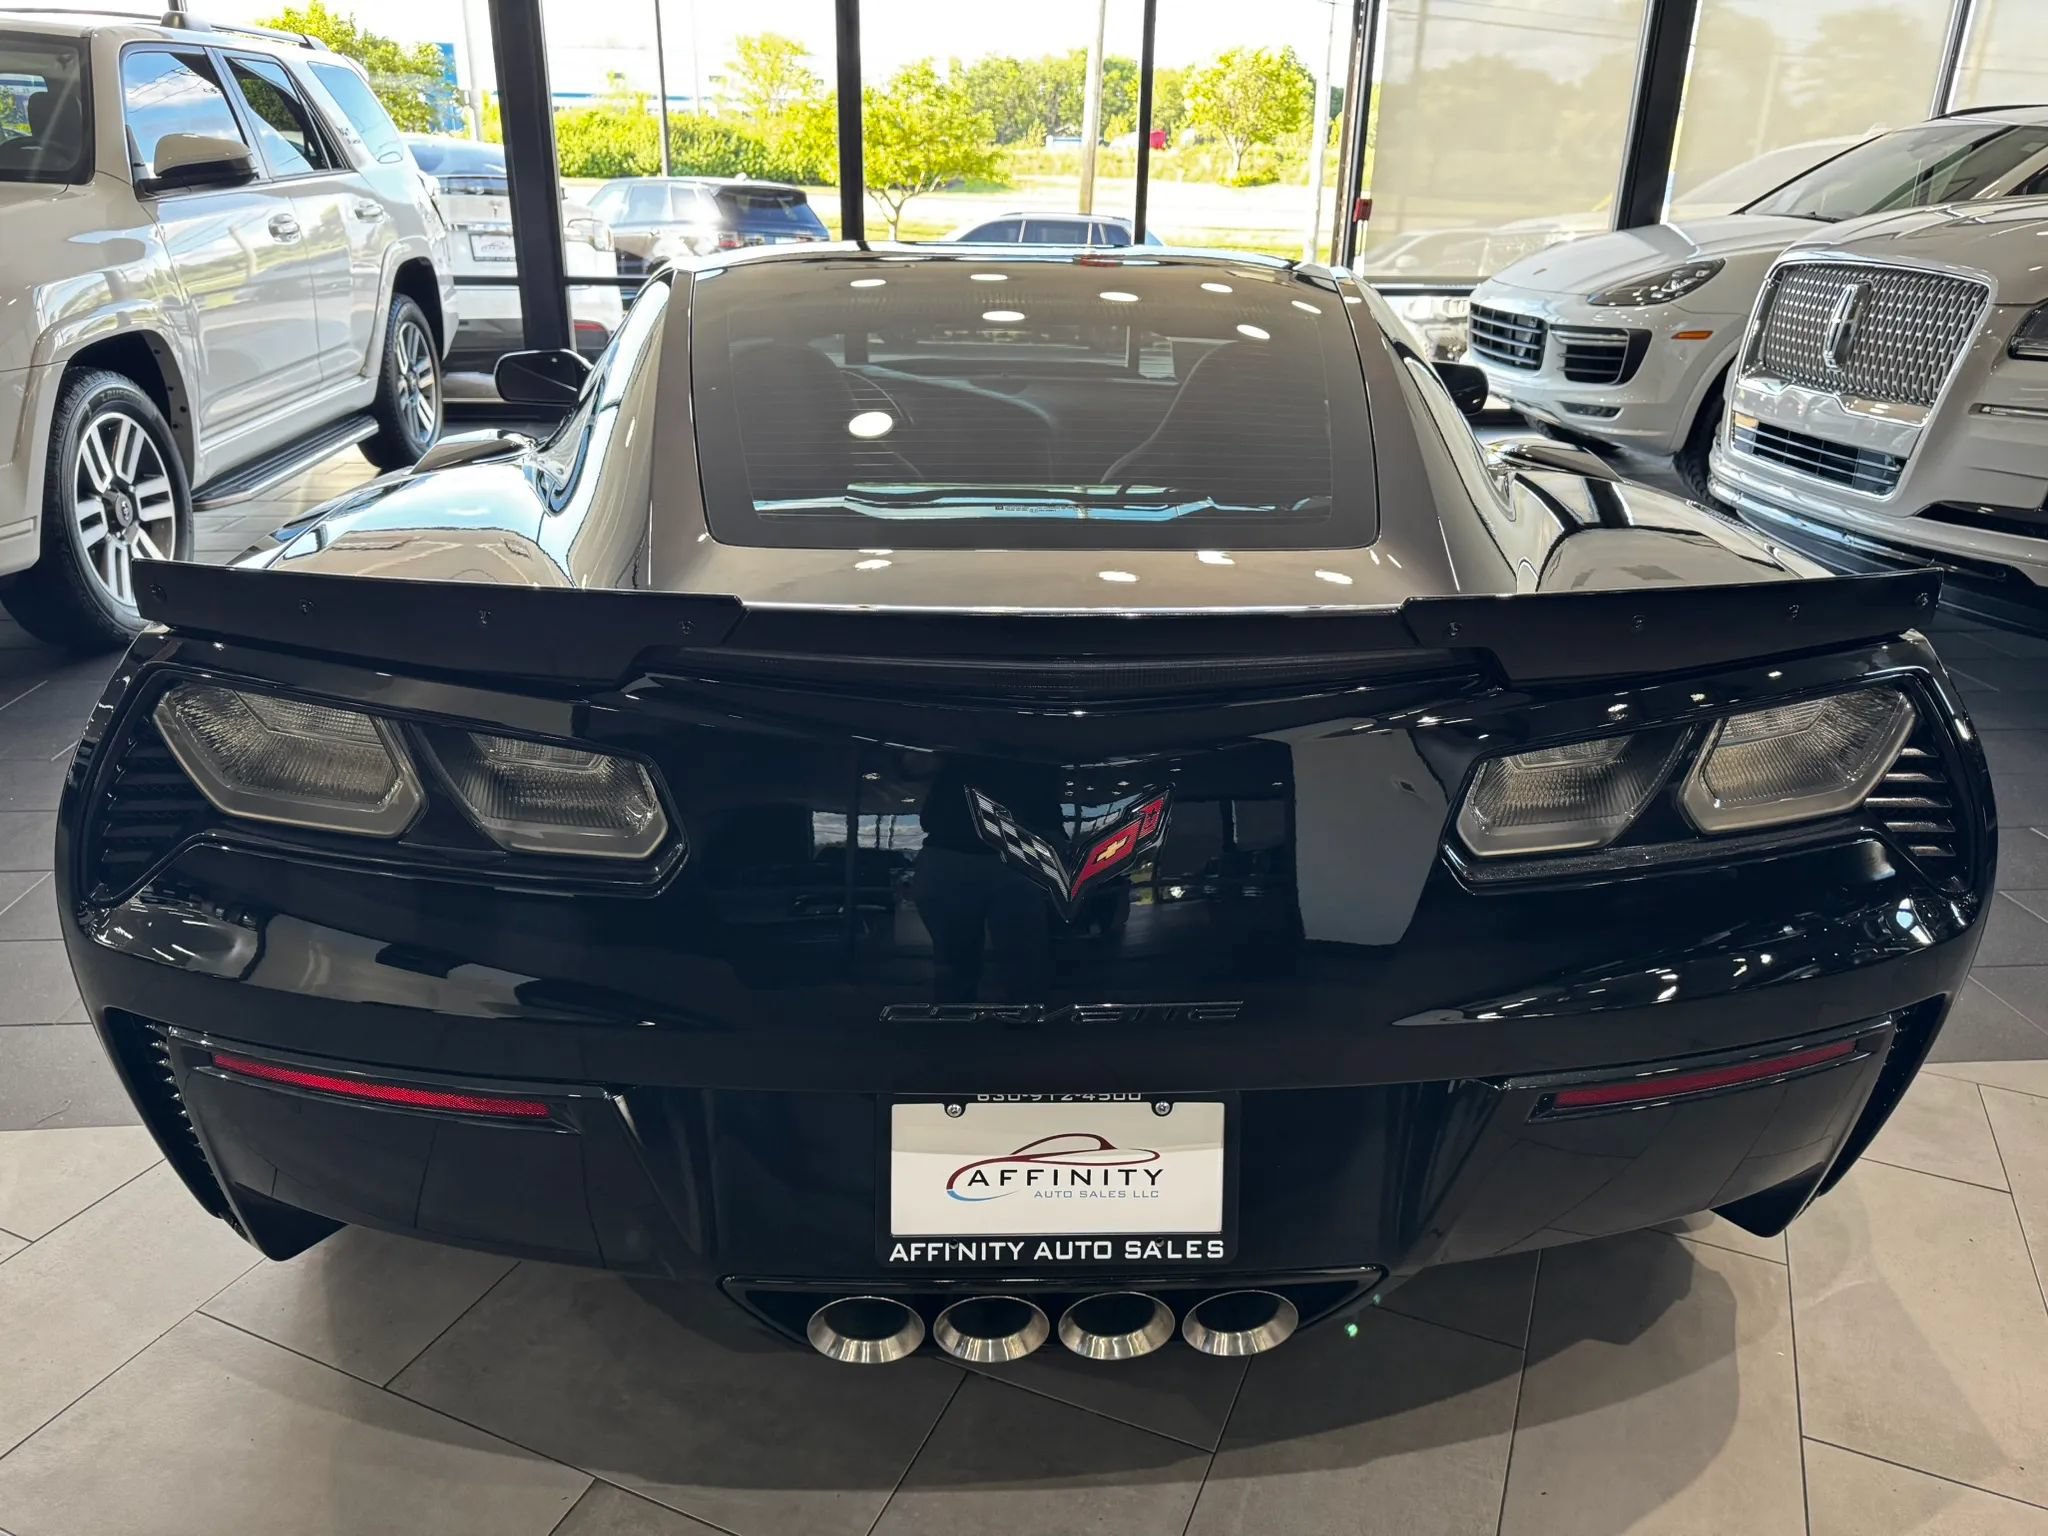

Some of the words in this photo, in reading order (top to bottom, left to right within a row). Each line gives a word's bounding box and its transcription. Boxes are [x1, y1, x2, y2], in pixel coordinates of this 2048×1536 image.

[879, 1001, 1244, 1023] CORVETTE
[967, 1168, 1164, 1187] AFFINITY
[1034, 1190, 1072, 1199] AUTO
[1079, 1190, 1126, 1199] SALES
[1133, 1190, 1159, 1199] LLC
[889, 1242, 1025, 1262] AFFINITY
[1033, 1241, 1112, 1260] AUTO
[1124, 1240, 1225, 1259] SALES
